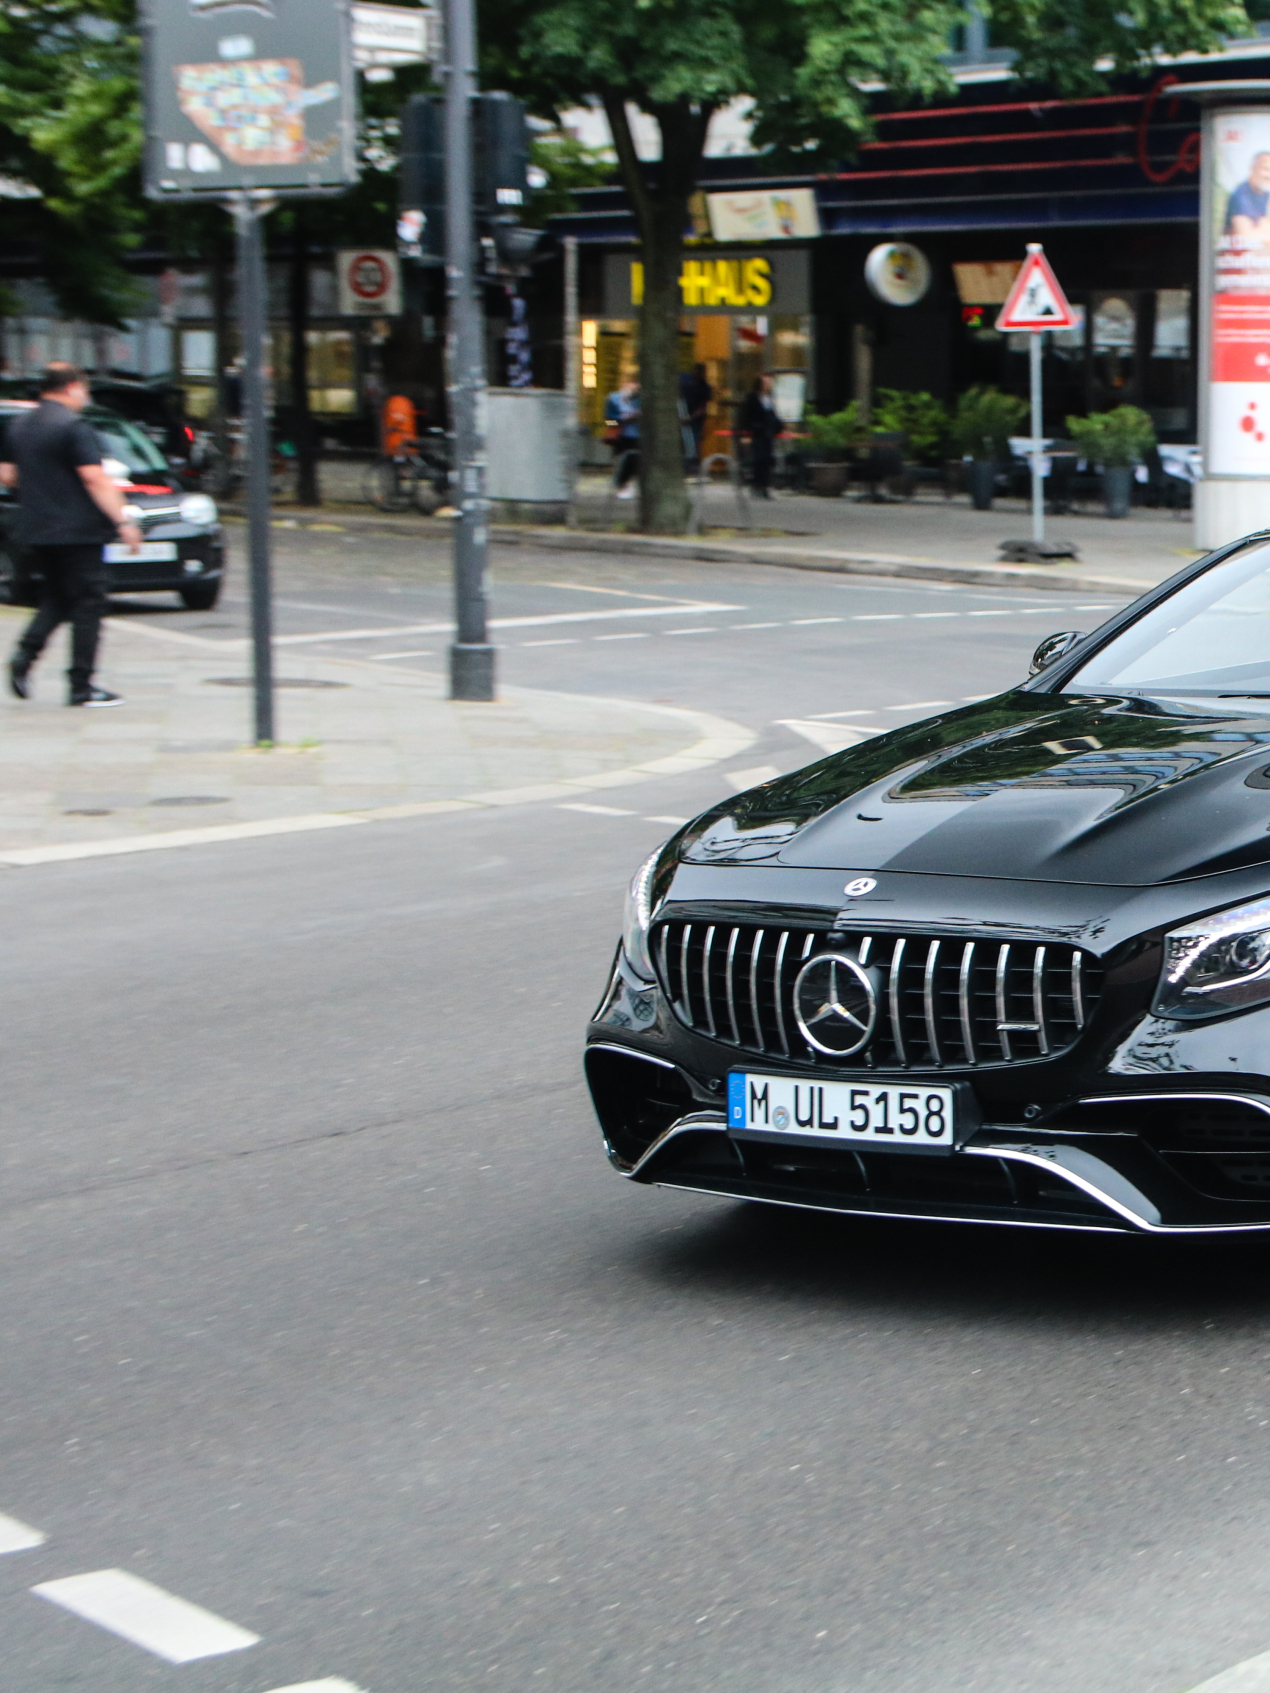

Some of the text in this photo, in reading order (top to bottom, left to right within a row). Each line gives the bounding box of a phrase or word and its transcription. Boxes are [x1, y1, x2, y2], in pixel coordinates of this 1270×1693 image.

[733, 1106, 743, 1119] D
[749, 1080, 946, 1138] M UL 5158
